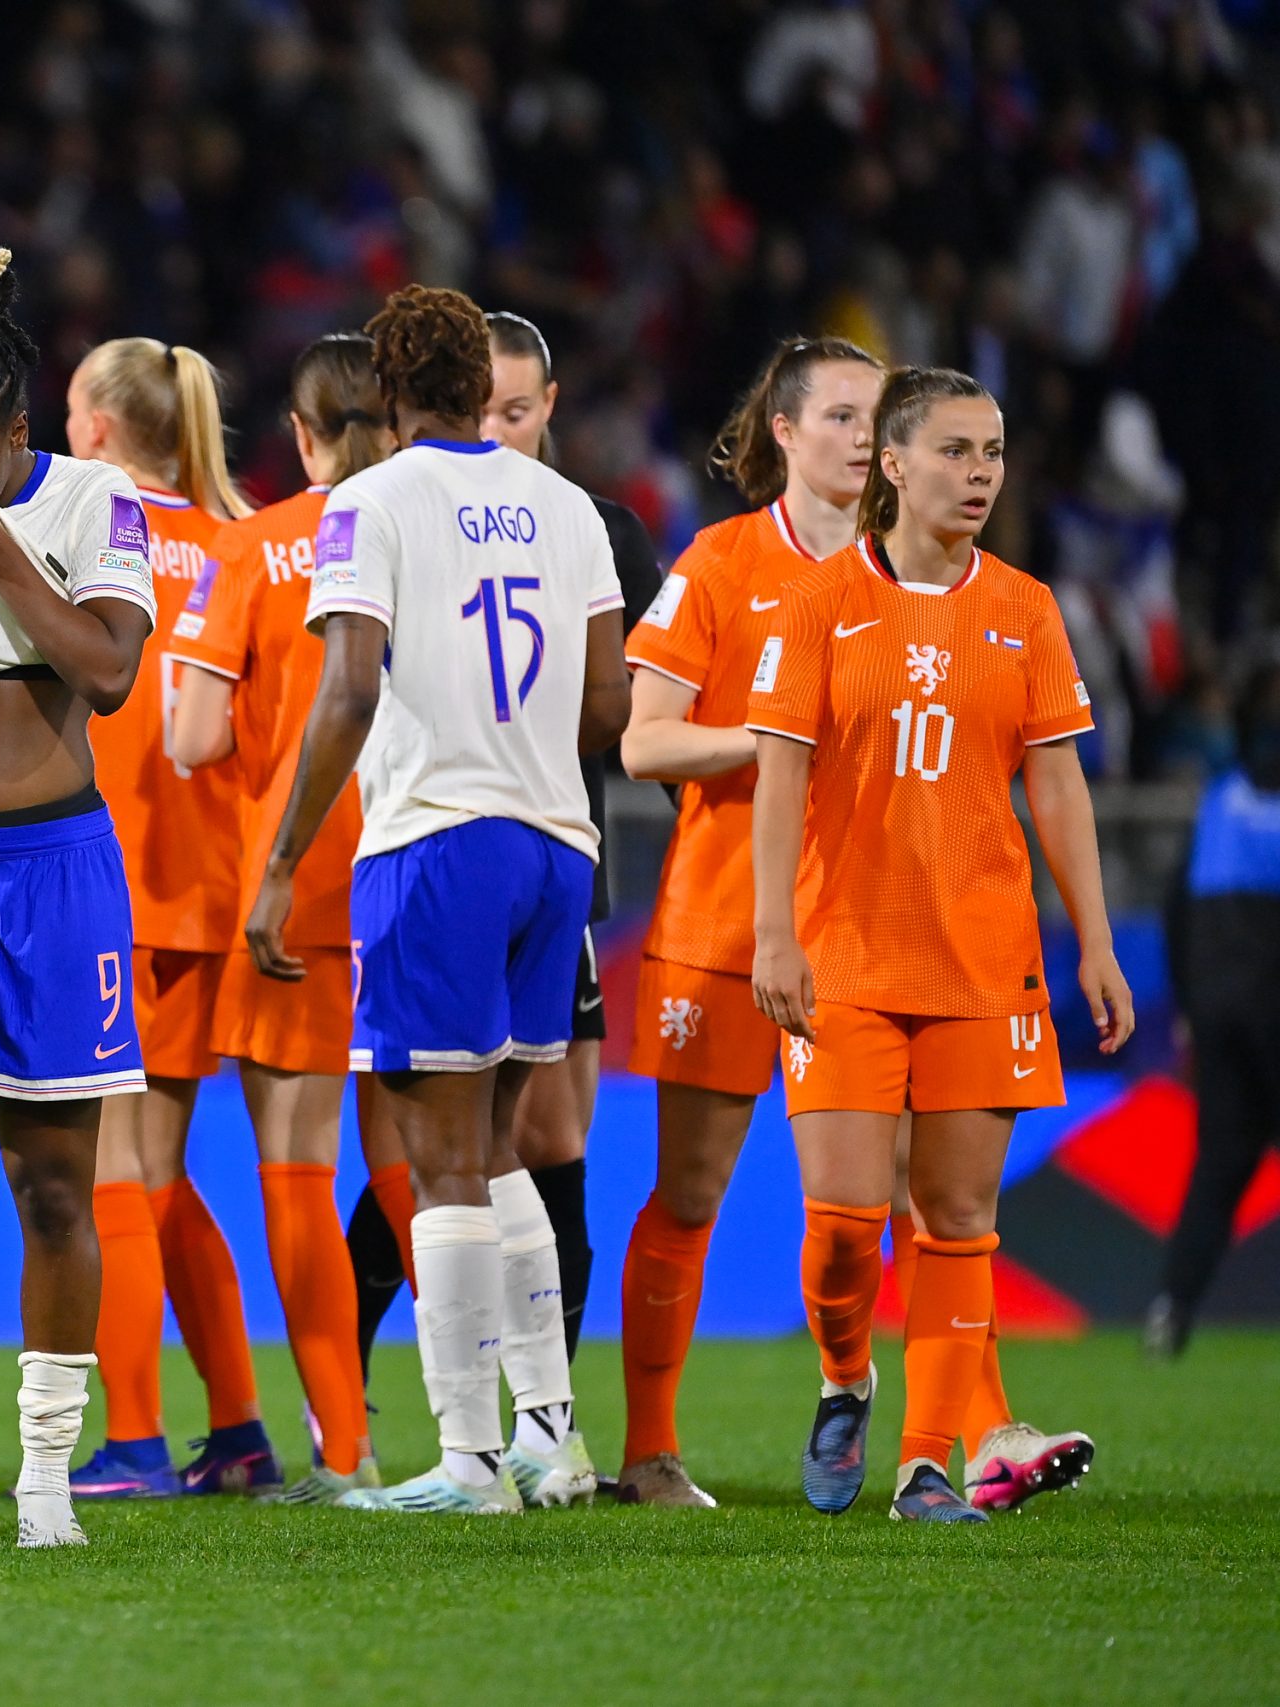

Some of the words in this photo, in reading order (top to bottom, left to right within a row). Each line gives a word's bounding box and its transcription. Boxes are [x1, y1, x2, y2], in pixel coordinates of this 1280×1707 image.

[263, 537, 317, 585] ke
[458, 506, 536, 543] GAGO
[461, 576, 545, 723] 15
[891, 699, 955, 782] 10
[97, 950, 122, 1033] 9
